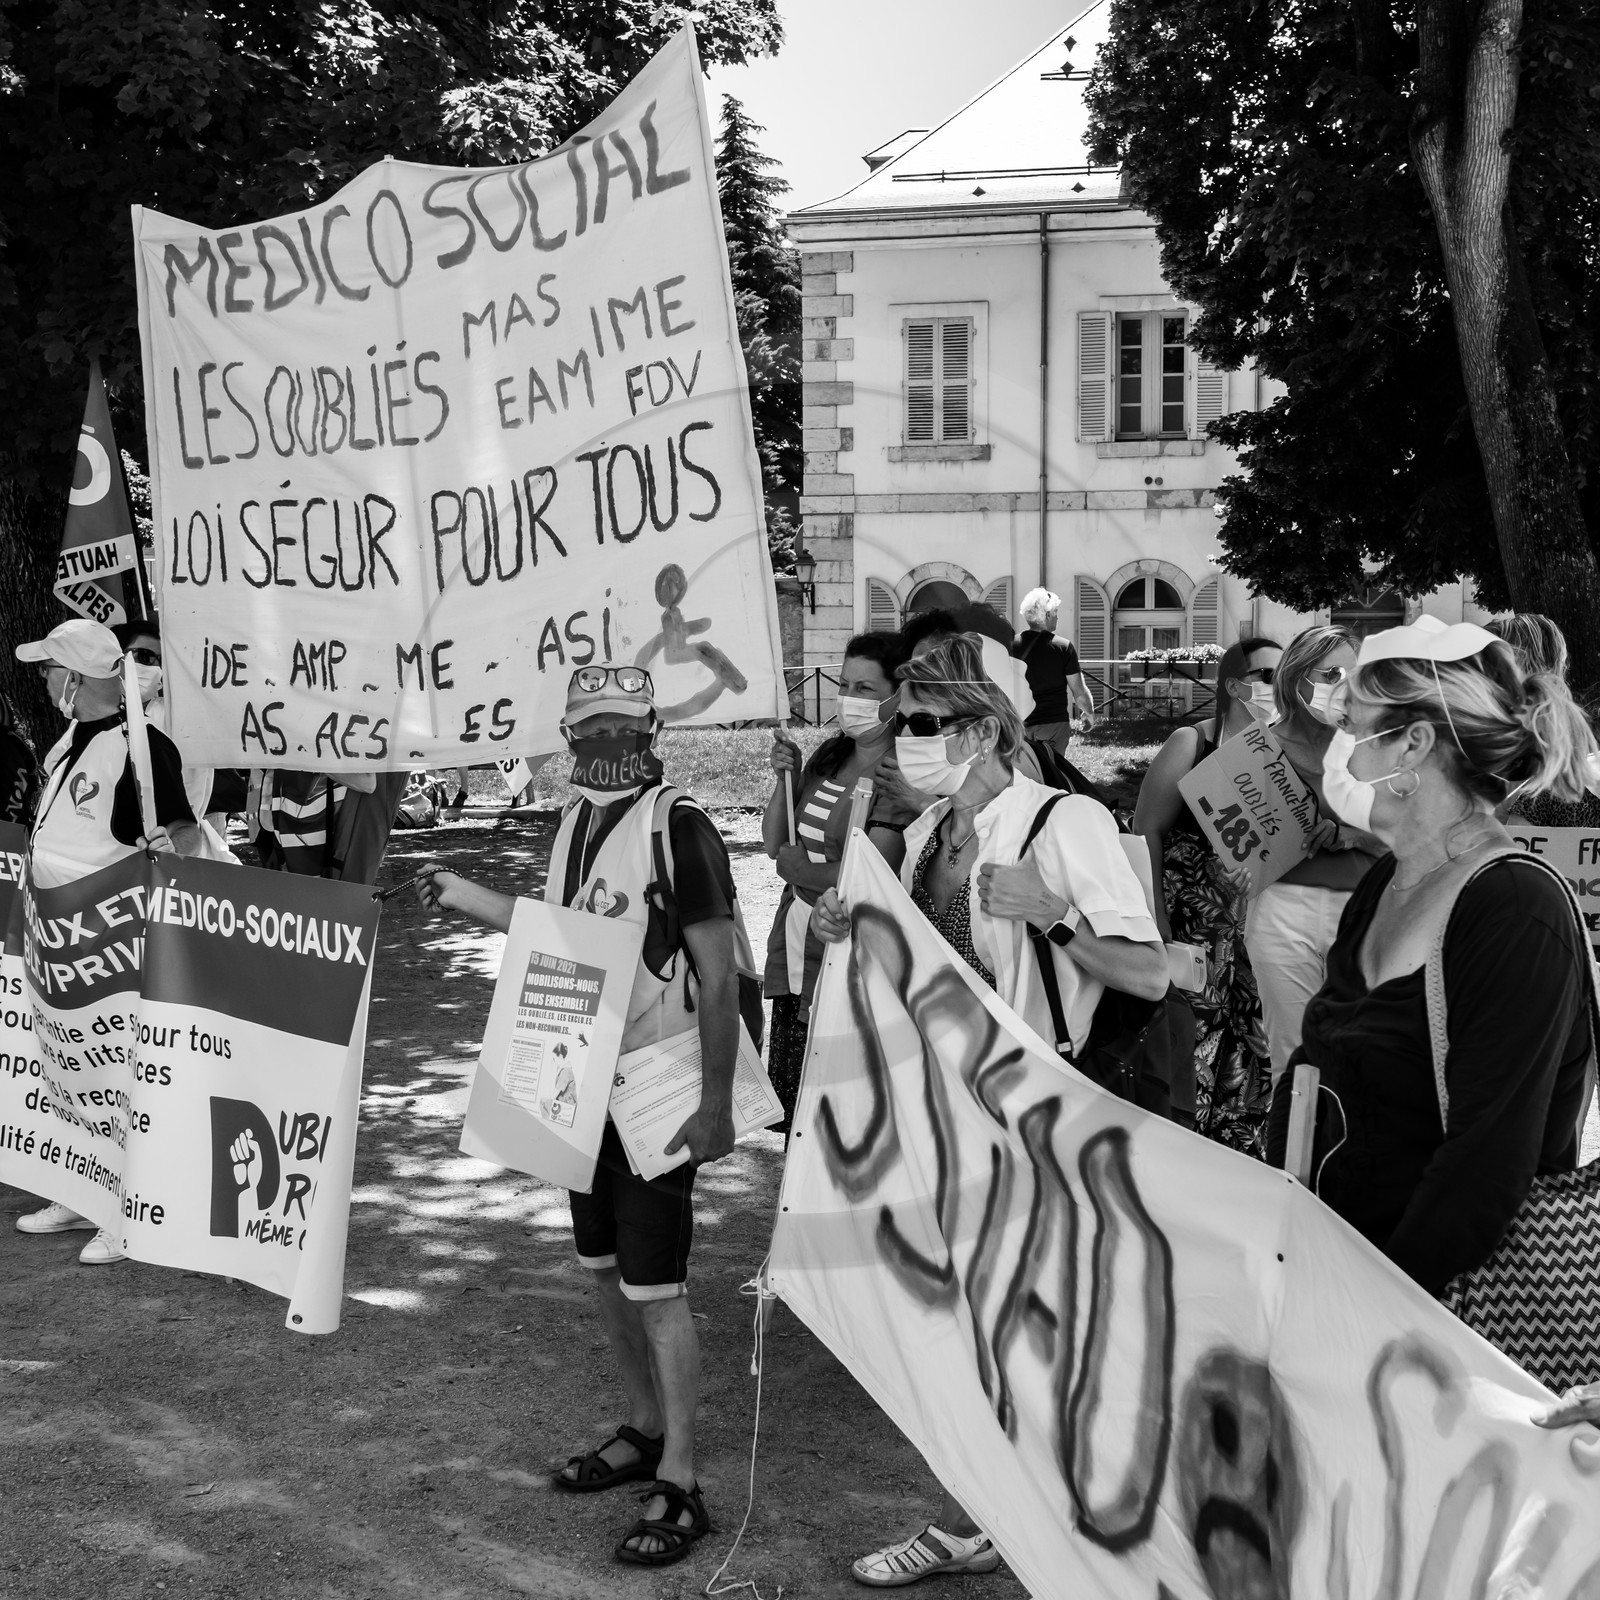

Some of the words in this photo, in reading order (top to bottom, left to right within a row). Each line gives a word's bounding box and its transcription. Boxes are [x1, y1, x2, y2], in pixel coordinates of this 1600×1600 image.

[164, 188, 413, 318] MEDICO
[422, 99, 692, 270] SOCIAL
[463, 273, 562, 360] MAS
[589, 274, 696, 358] IME
[173, 360, 261, 470] LES
[494, 348, 596, 430] EAM
[624, 349, 703, 417] FDV
[239, 480, 402, 592] SÉGUR
[430, 466, 568, 593] POUR
[574, 421, 723, 545] TOUS
[289, 638, 347, 692] AMP
[395, 638, 455, 692] ME
[241, 701, 288, 757] AS
[315, 711, 390, 761] AES
[459, 698, 516, 743] ES
[1243, 728, 1274, 754] APF
[95, 885, 146, 928] ET
[147, 878, 367, 966] MÉDICO-SOCIAUX
[526, 972, 600, 995] MOBILISONS-NOUS,
[556, 959, 577, 975] 2021
[523, 991, 545, 1006] TOUS
[544, 993, 585, 1011] ENSEMBLE
[83, 1043, 126, 1068] lits
[91, 1014, 125, 1036] de
[189, 1024, 232, 1060] tous
[25, 1088, 51, 1114] de
[40, 1137, 61, 1165] de
[65, 1145, 122, 1198] traitement
[245, 1211, 294, 1247] MÊME
